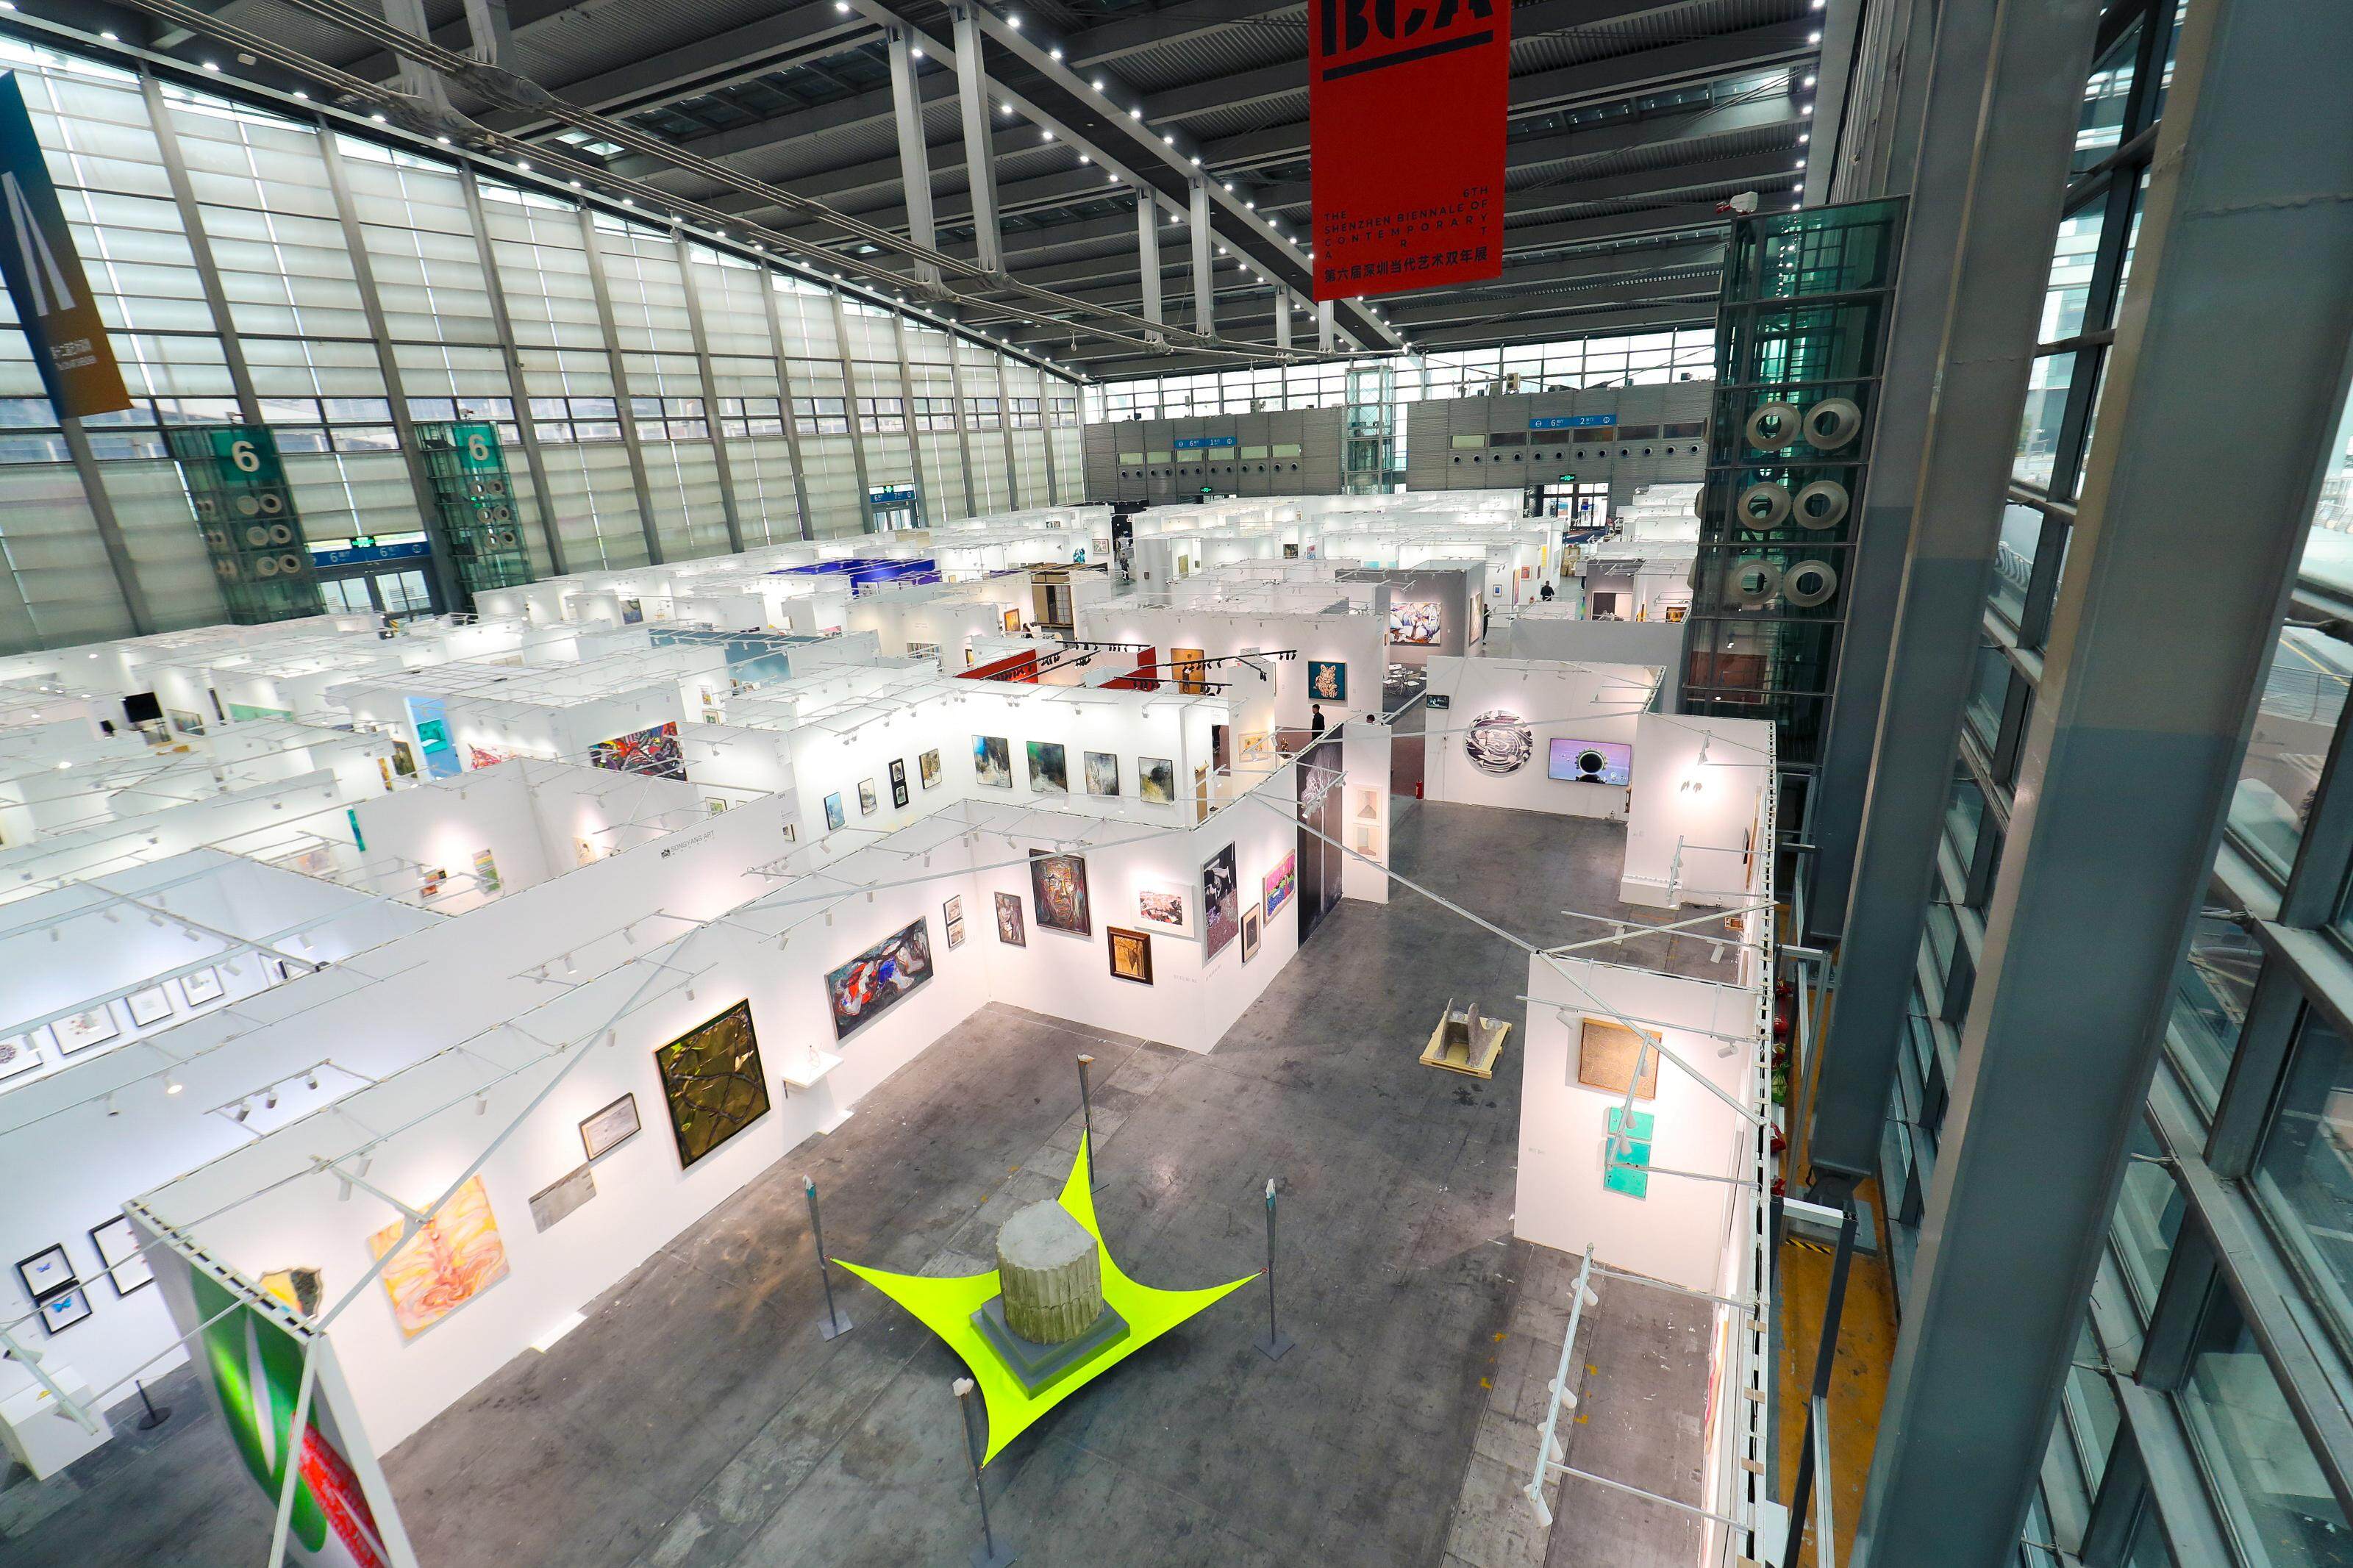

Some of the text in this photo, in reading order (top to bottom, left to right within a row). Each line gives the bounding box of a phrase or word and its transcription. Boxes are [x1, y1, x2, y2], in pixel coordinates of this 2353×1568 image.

[1324, 186, 1488, 222] THE 6TH
[1324, 199, 1488, 235] SHENZHEN BIENNALE OF
[1324, 213, 1488, 247] CONTEMPORARY
[1324, 246, 1488, 283] 第六届深圳当代艺术双年展
[231, 440, 260, 473] 6
[468, 435, 490, 461] 6
[329, 552, 338, 562] 6
[379, 547, 388, 557] 6
